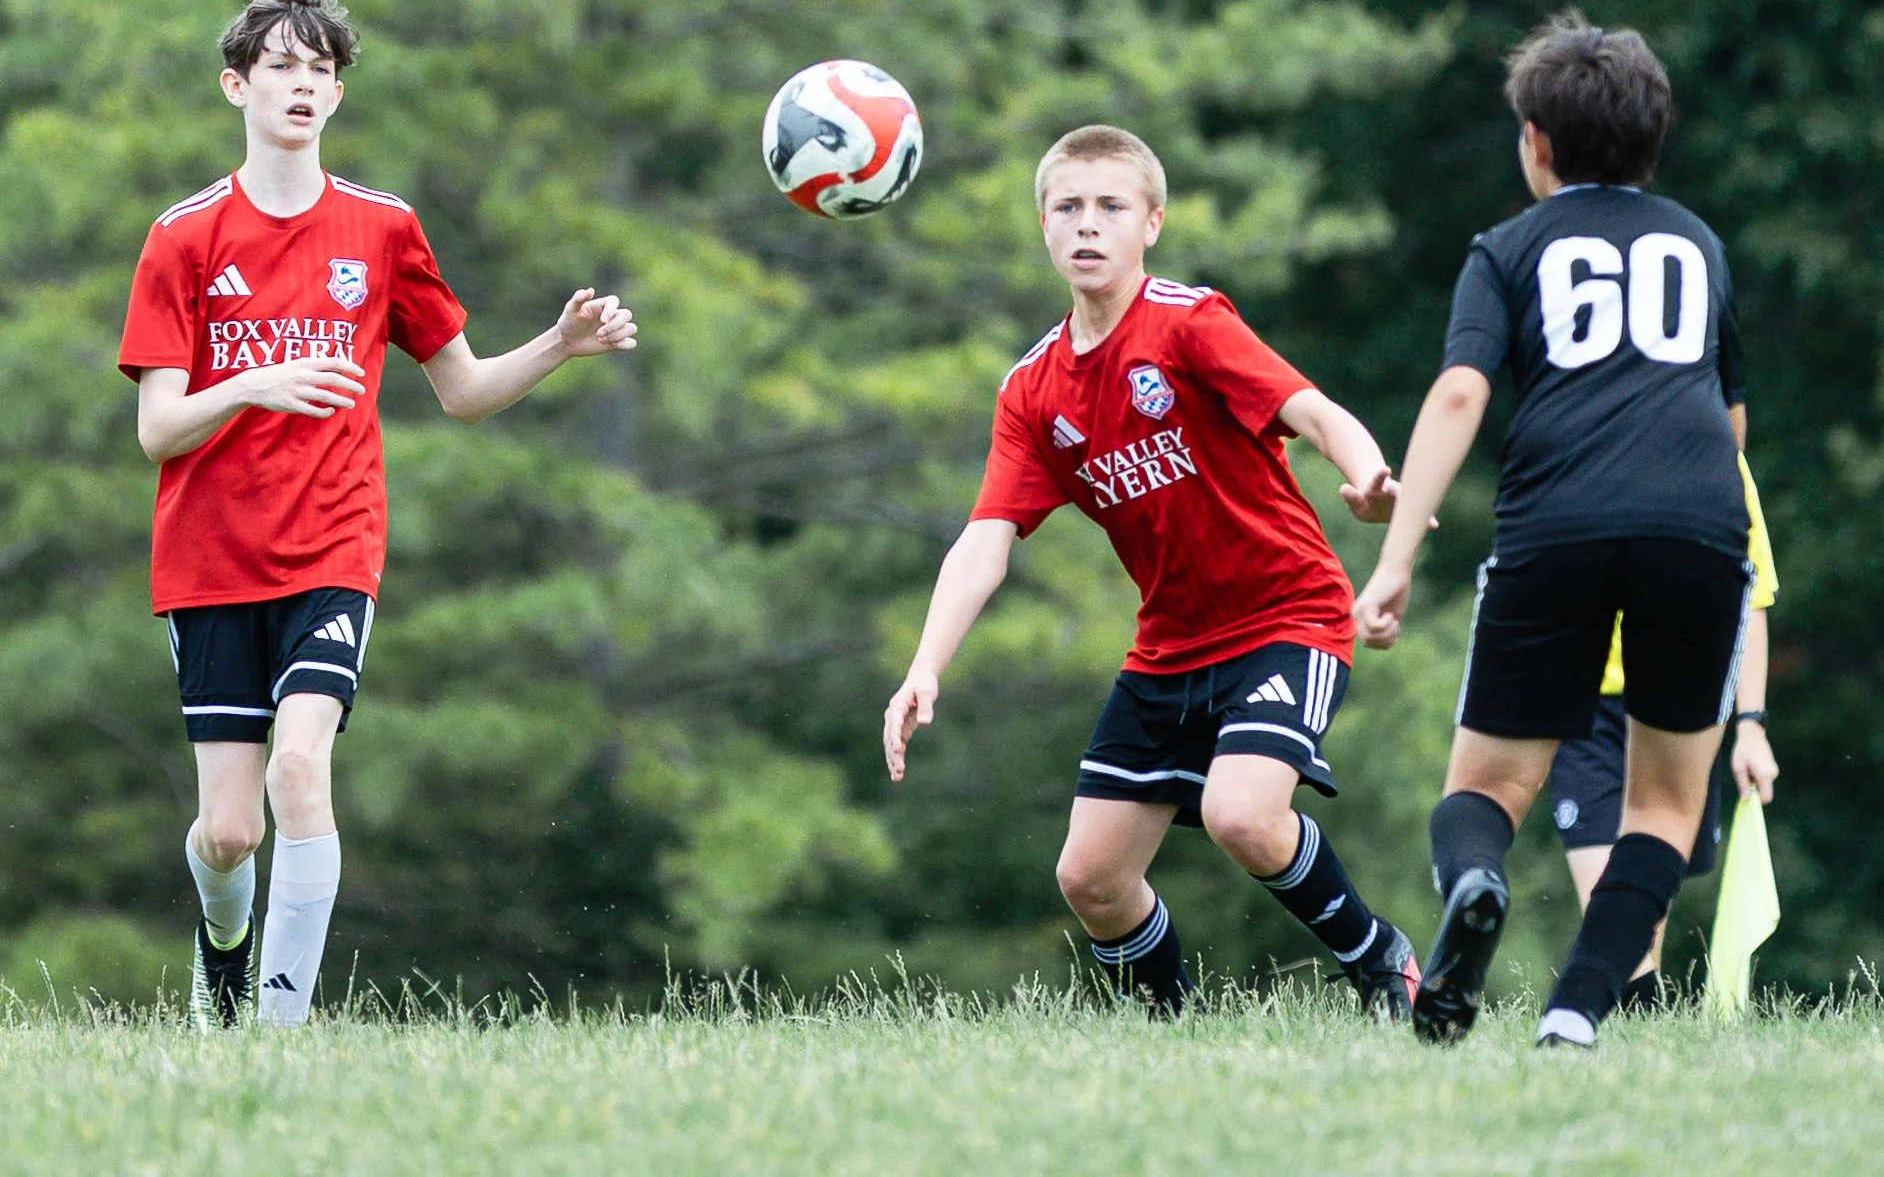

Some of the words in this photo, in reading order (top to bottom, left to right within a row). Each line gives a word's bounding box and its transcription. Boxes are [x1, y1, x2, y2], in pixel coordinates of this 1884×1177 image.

[1537, 232, 1708, 369] 60
[208, 320, 263, 342] FOX
[267, 317, 358, 343] VALLEY
[1090, 447, 1198, 509] YERN
[1093, 426, 1186, 476] VALLEY
